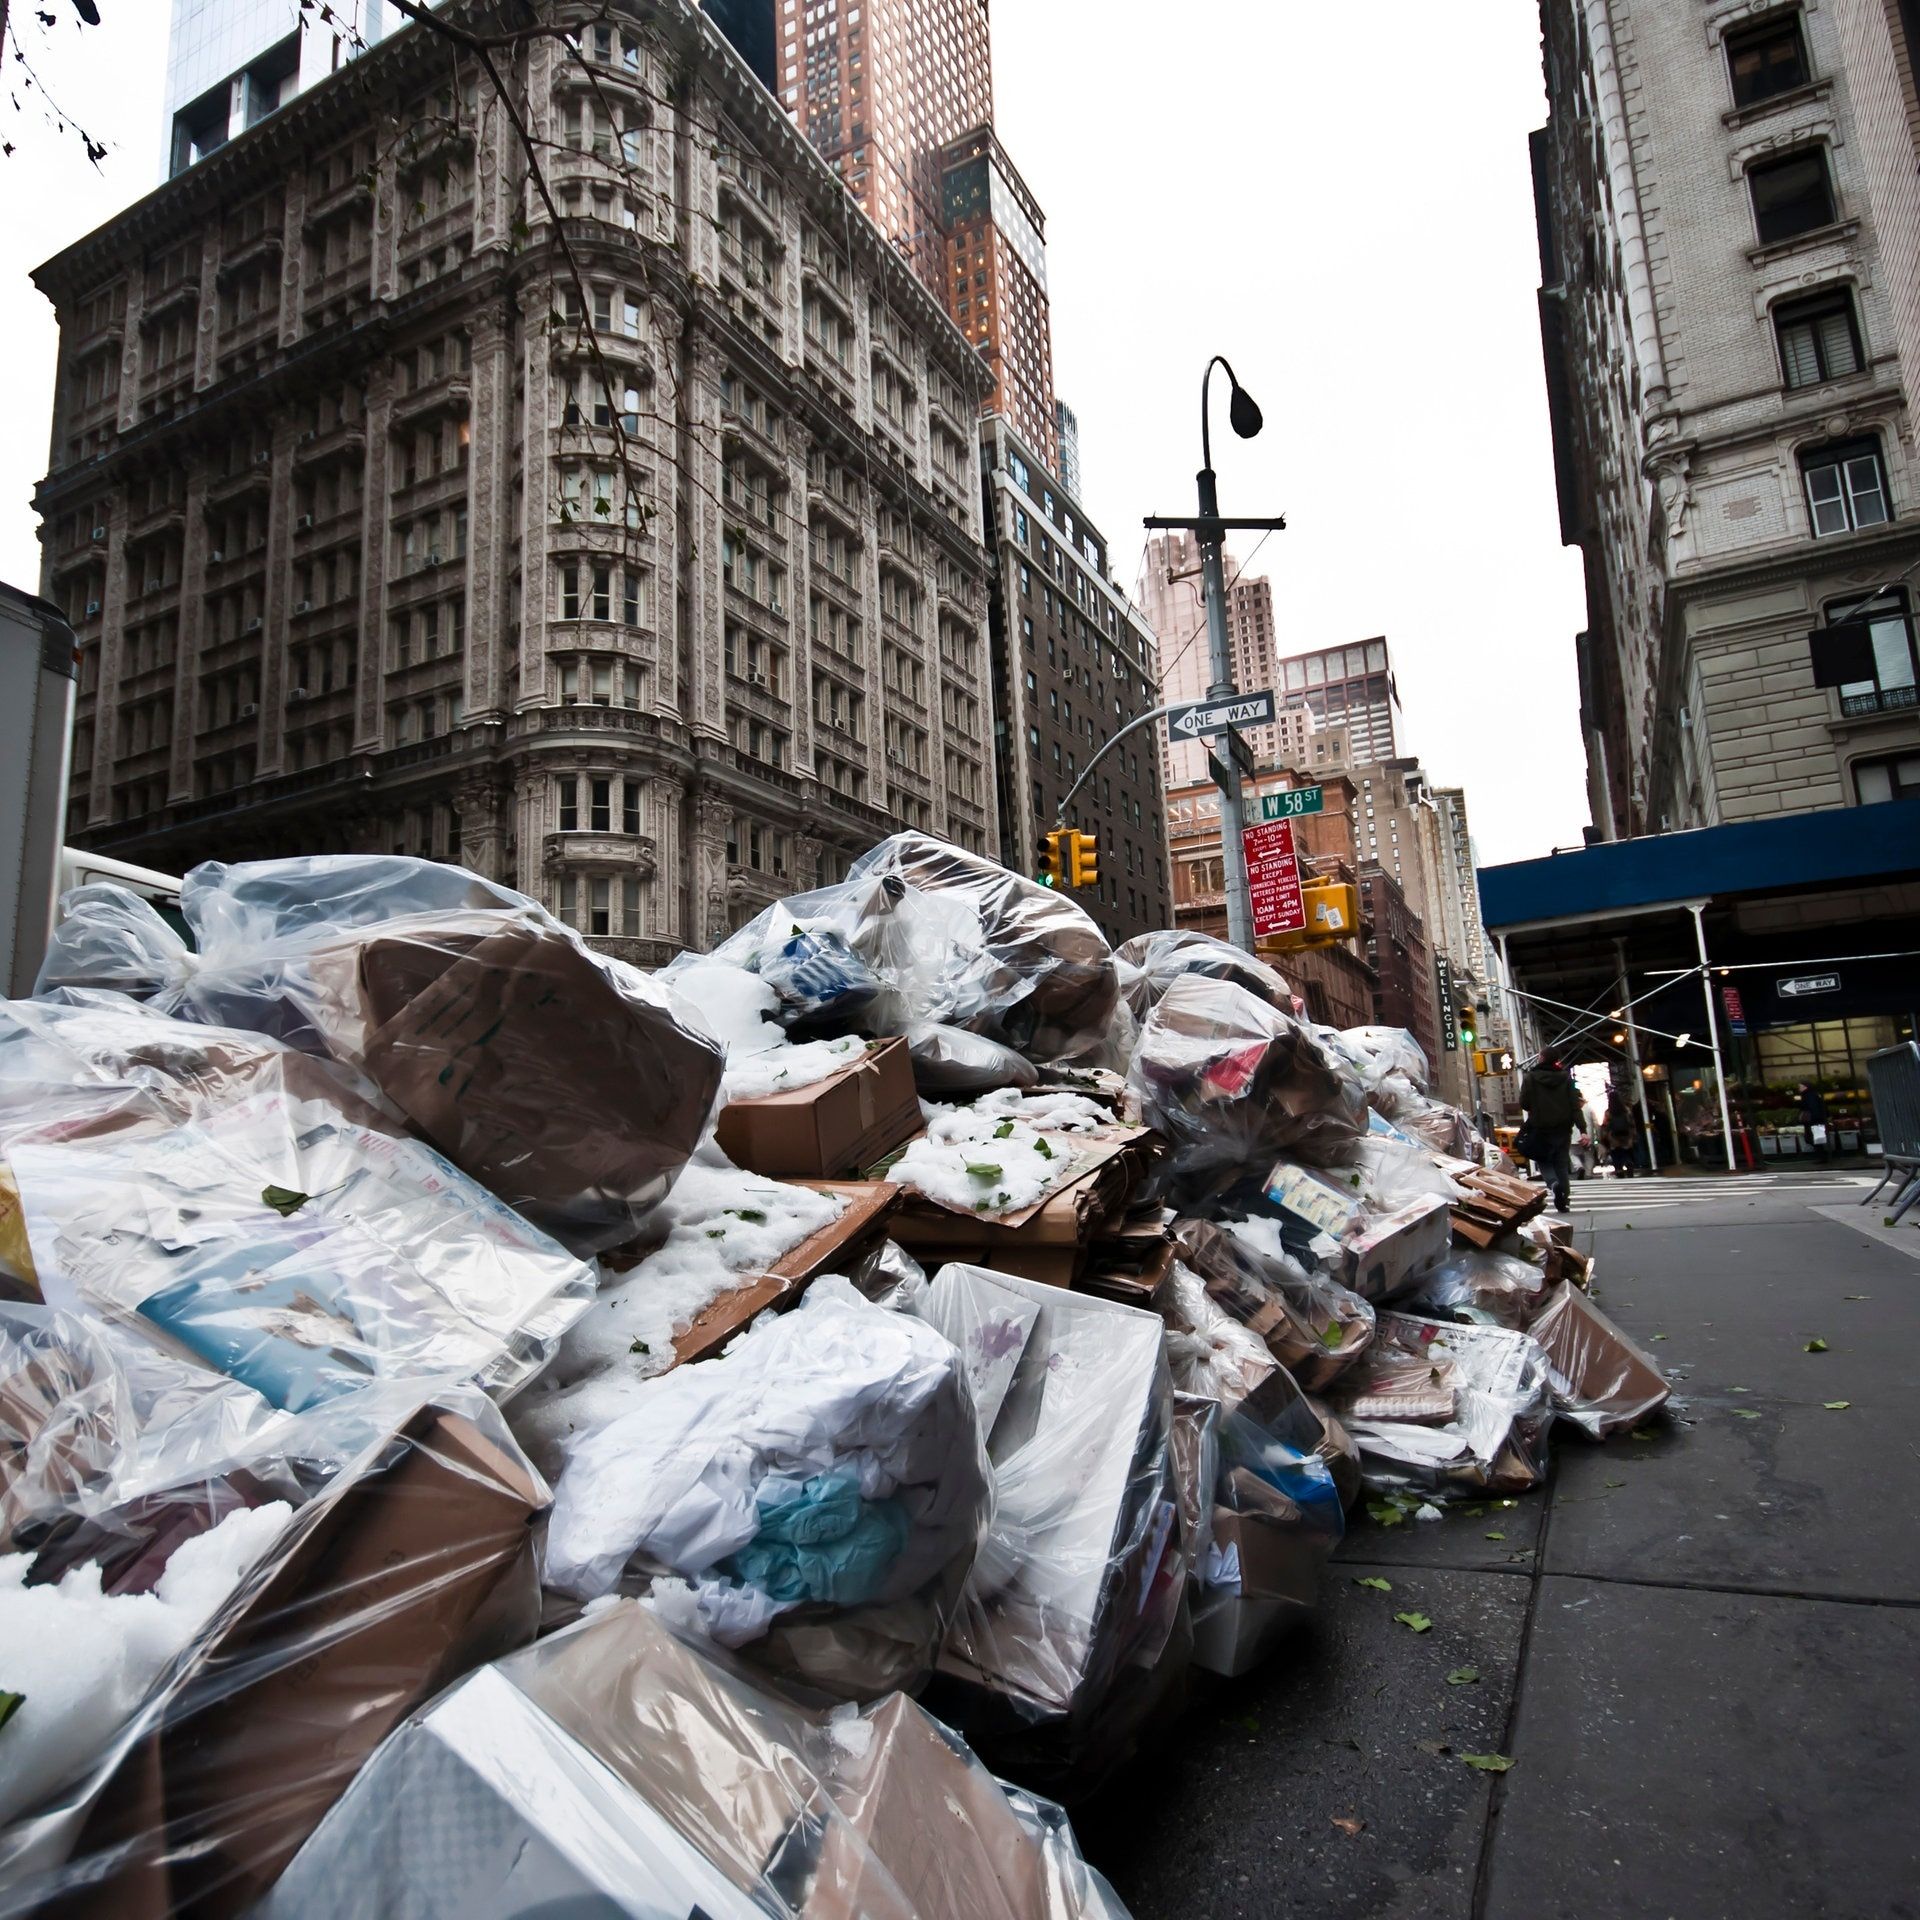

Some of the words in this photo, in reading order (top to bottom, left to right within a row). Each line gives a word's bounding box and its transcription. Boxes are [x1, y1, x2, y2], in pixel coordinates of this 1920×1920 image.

[1184, 712, 1213, 729] ONE
[1228, 702, 1260, 720] WAY
[1267, 797, 1278, 816] W
[1285, 792, 1303, 814] 58
[1305, 789, 1318, 801] ST
[1245, 831, 1254, 840] NO
[1257, 822, 1287, 836] STANDING
[1250, 866, 1259, 874] NO
[1261, 858, 1293, 872] STANDING
[1250, 880, 1276, 890] COMMERCIAL
[1278, 875, 1297, 883] VEHICLES
[1262, 870, 1283, 880] EXCEPT
[1253, 888, 1275, 898] METERED
[1276, 883, 1297, 893] PARKING
[1275, 892, 1290, 900] LIMIT
[1256, 904, 1274, 915] 10AM
[1282, 899, 1298, 908] 4PM
[1255, 913, 1276, 923] EXCEPT
[1278, 908, 1300, 918] SUNDAY
[1816, 979, 1832, 987] WAY
[1437, 961, 1455, 1048] WELLINGTON
